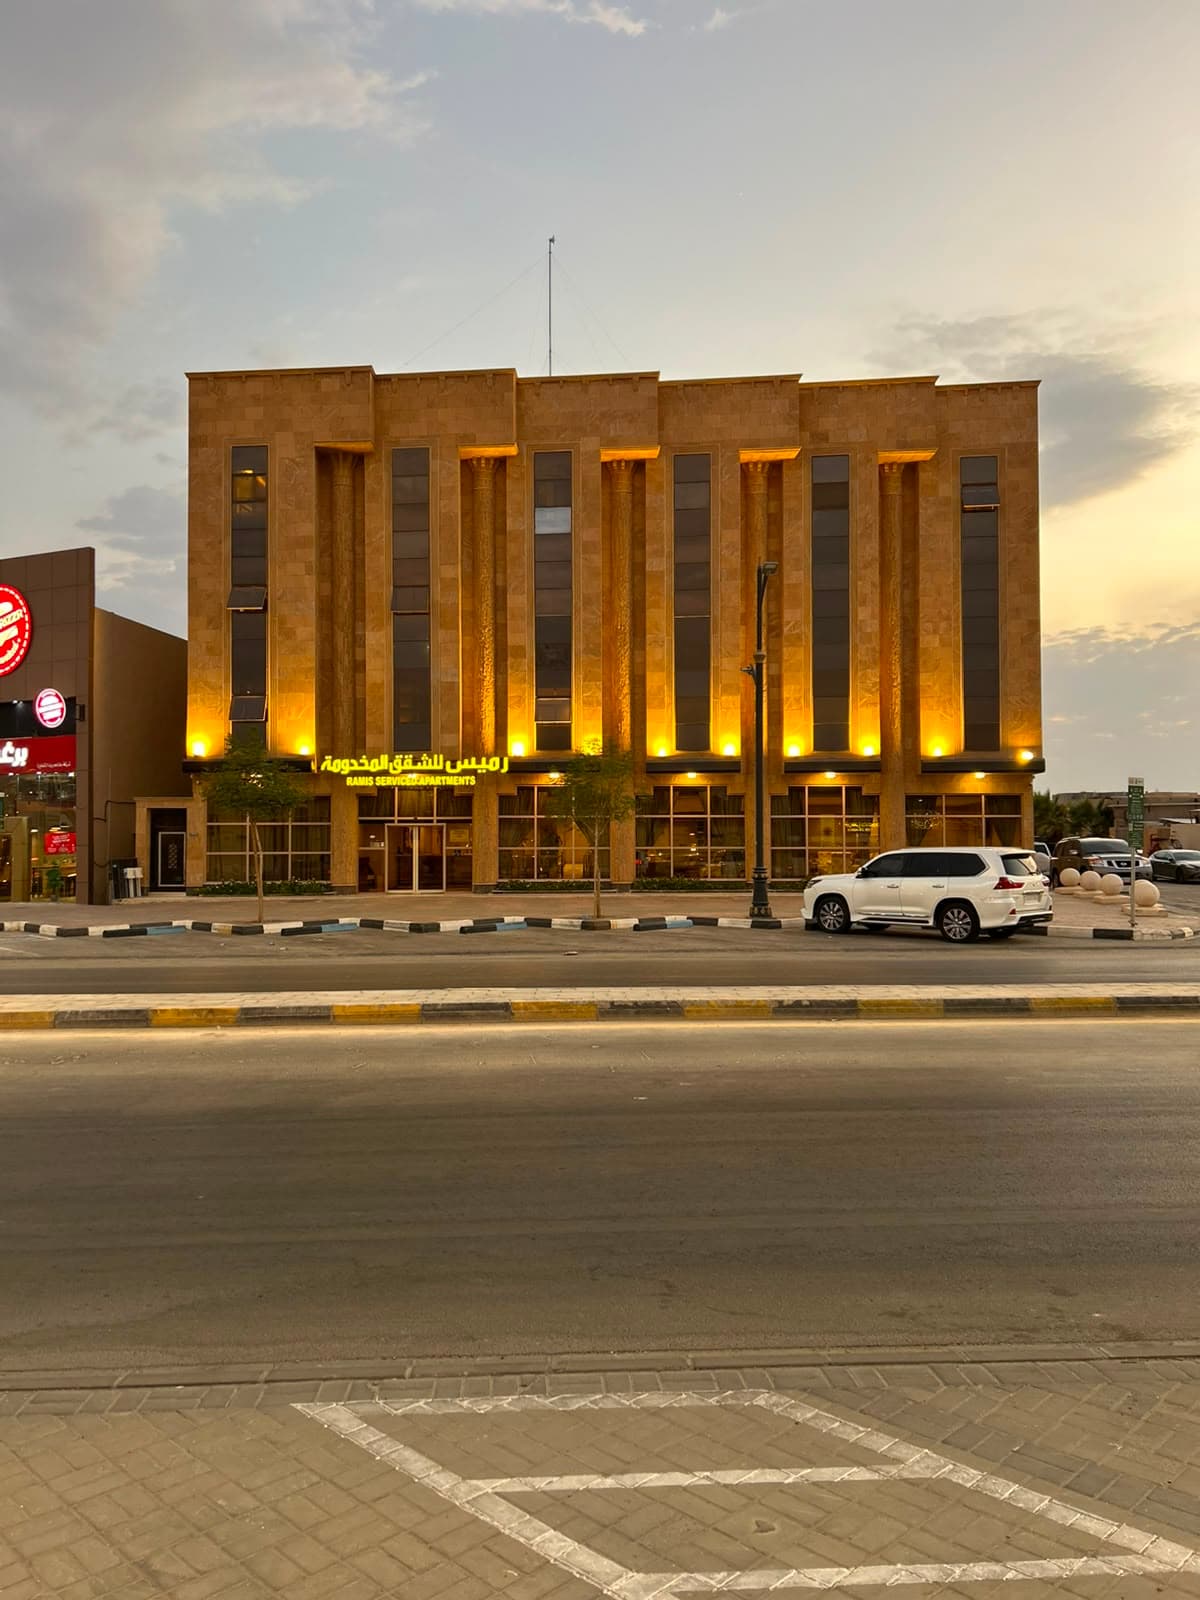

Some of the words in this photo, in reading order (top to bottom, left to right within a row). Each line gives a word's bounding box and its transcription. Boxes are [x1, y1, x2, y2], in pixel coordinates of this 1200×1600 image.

[0, 740, 29, 767] برغ
[389, 753, 444, 774] للشقق
[320, 754, 389, 775] المخدومة
[445, 756, 509, 774] رميس
[346, 776, 374, 787] RAMIS
[375, 776, 417, 787] SERVICED
[416, 775, 476, 786] APARTMENTS
